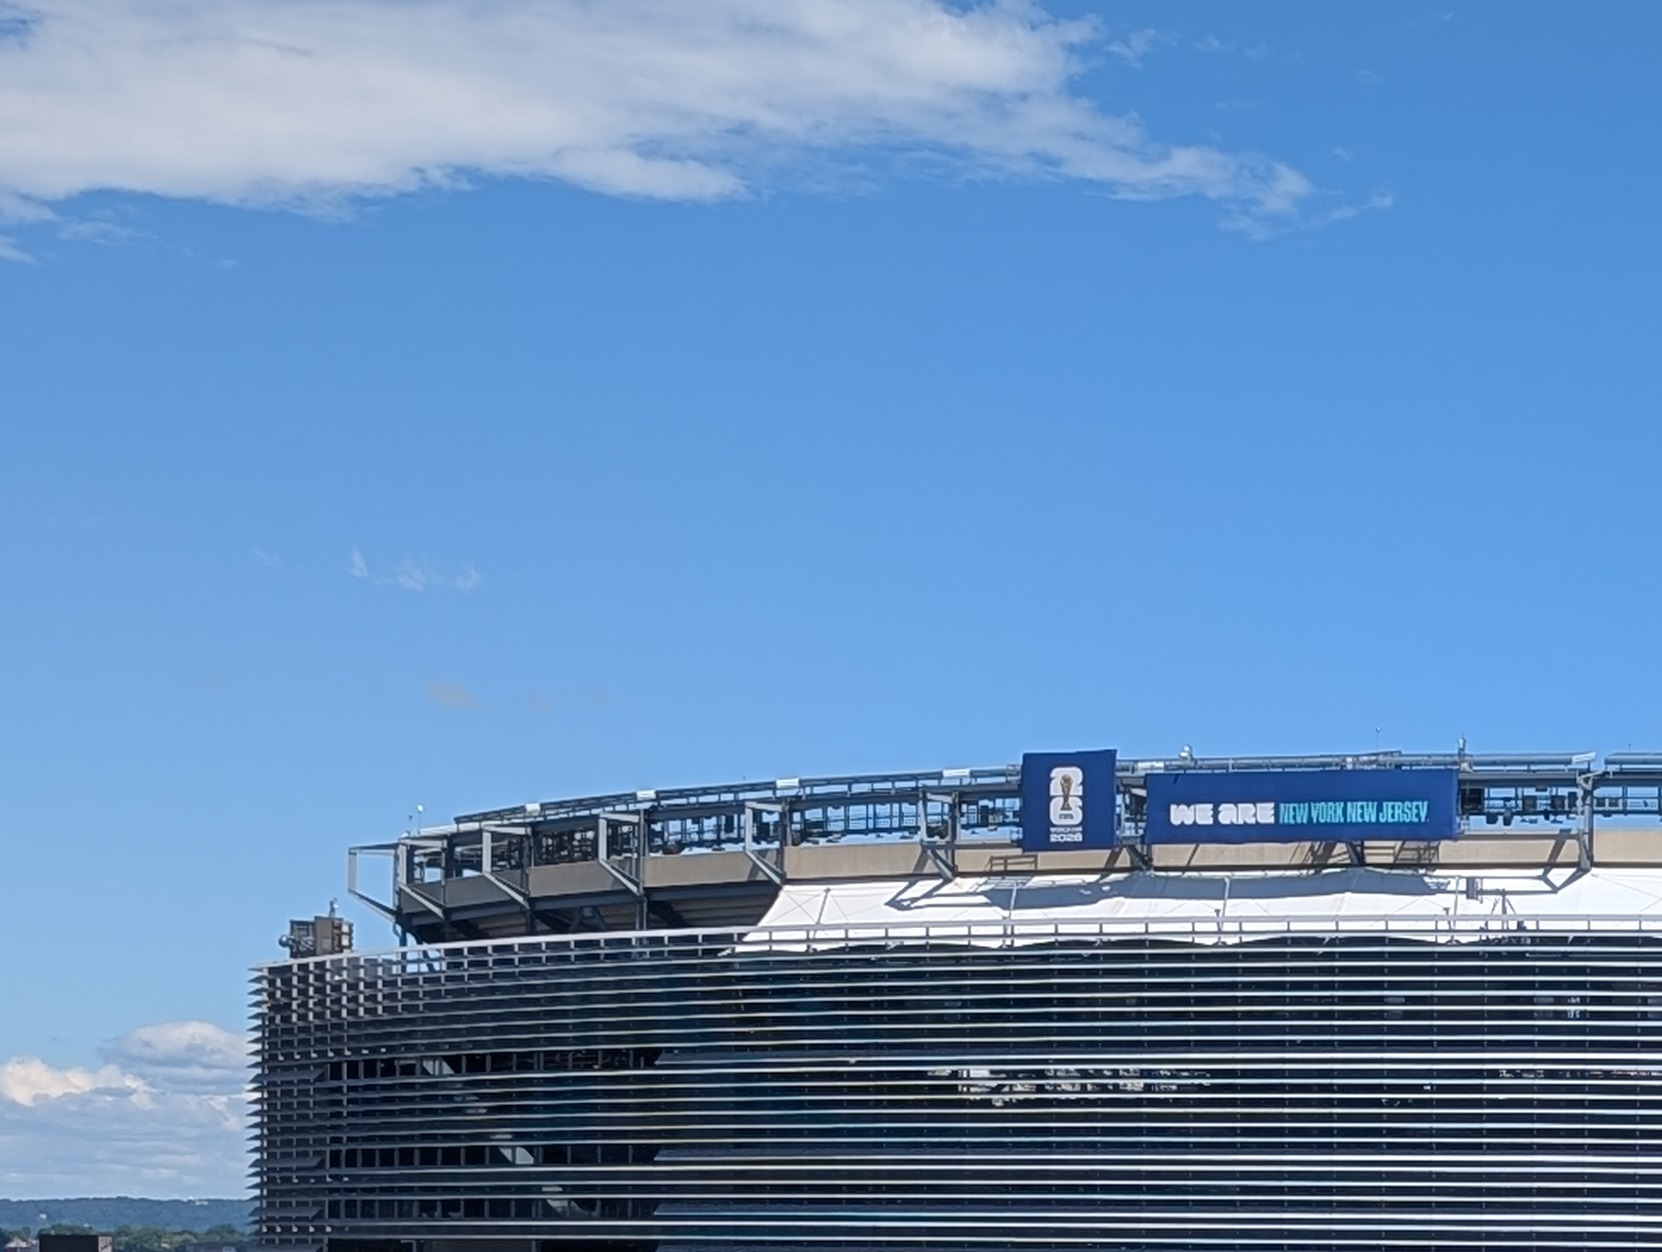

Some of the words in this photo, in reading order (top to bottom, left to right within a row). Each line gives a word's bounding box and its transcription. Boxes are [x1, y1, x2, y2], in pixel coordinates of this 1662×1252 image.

[1169, 803, 1214, 825] WE
[1218, 802, 1275, 825] ARE
[1279, 802, 1309, 824] NEW
[1310, 802, 1344, 824] YORK
[1346, 801, 1377, 823] NEW
[1049, 833, 1083, 842] 2026
